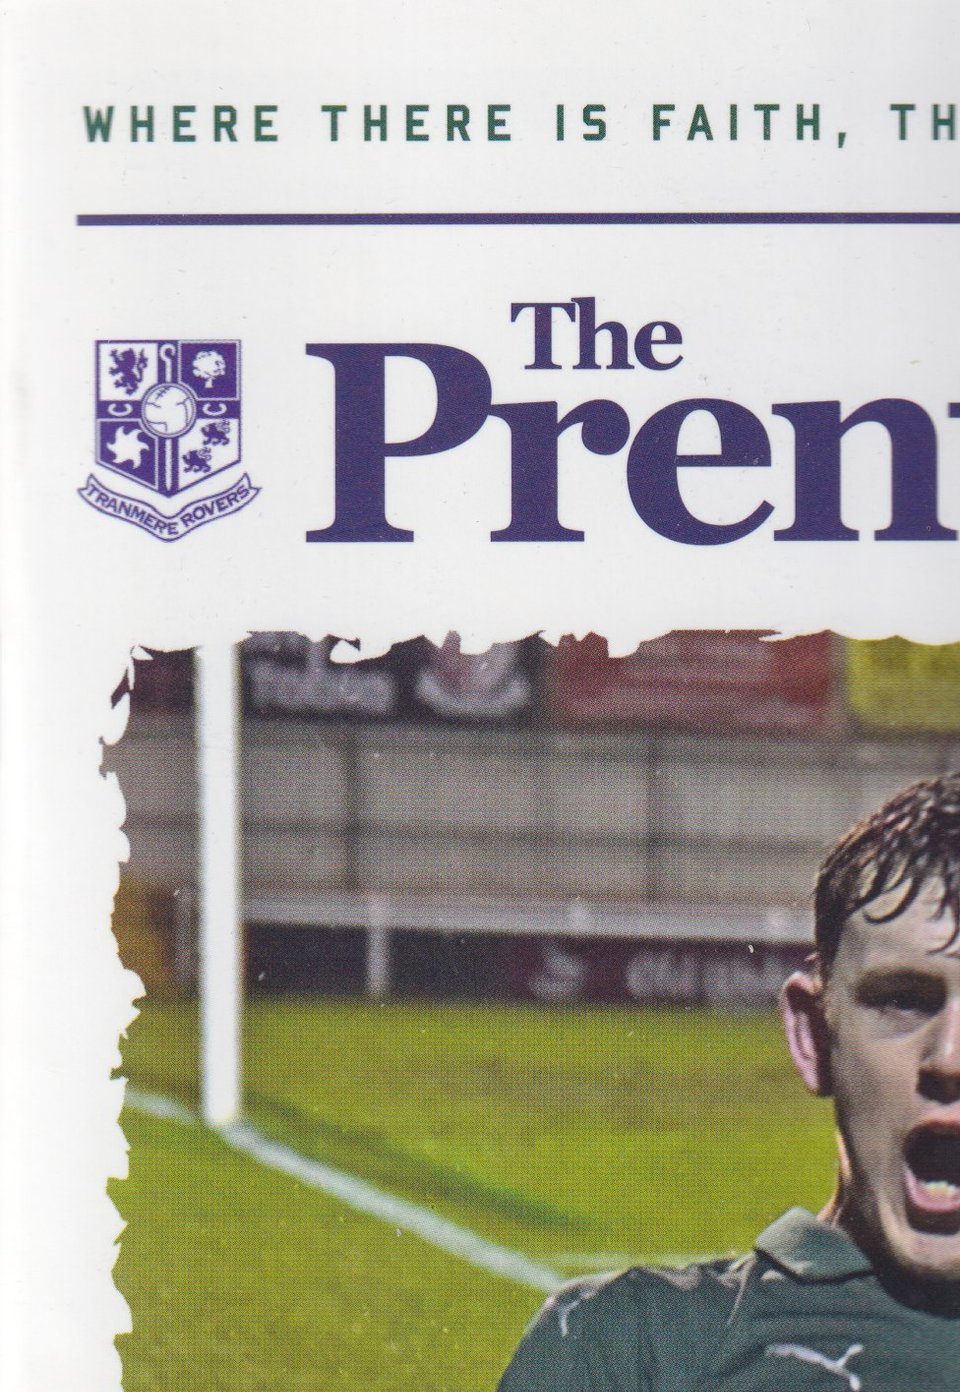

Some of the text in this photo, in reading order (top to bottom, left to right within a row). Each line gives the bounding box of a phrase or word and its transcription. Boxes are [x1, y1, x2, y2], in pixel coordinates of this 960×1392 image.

[83, 105, 278, 142] WHERE
[321, 104, 511, 141] THERE
[557, 104, 606, 141] IS
[653, 104, 846, 148] FAITH,
[511, 297, 683, 371] The
[87, 484, 250, 535] TRANMERE ROVERS
